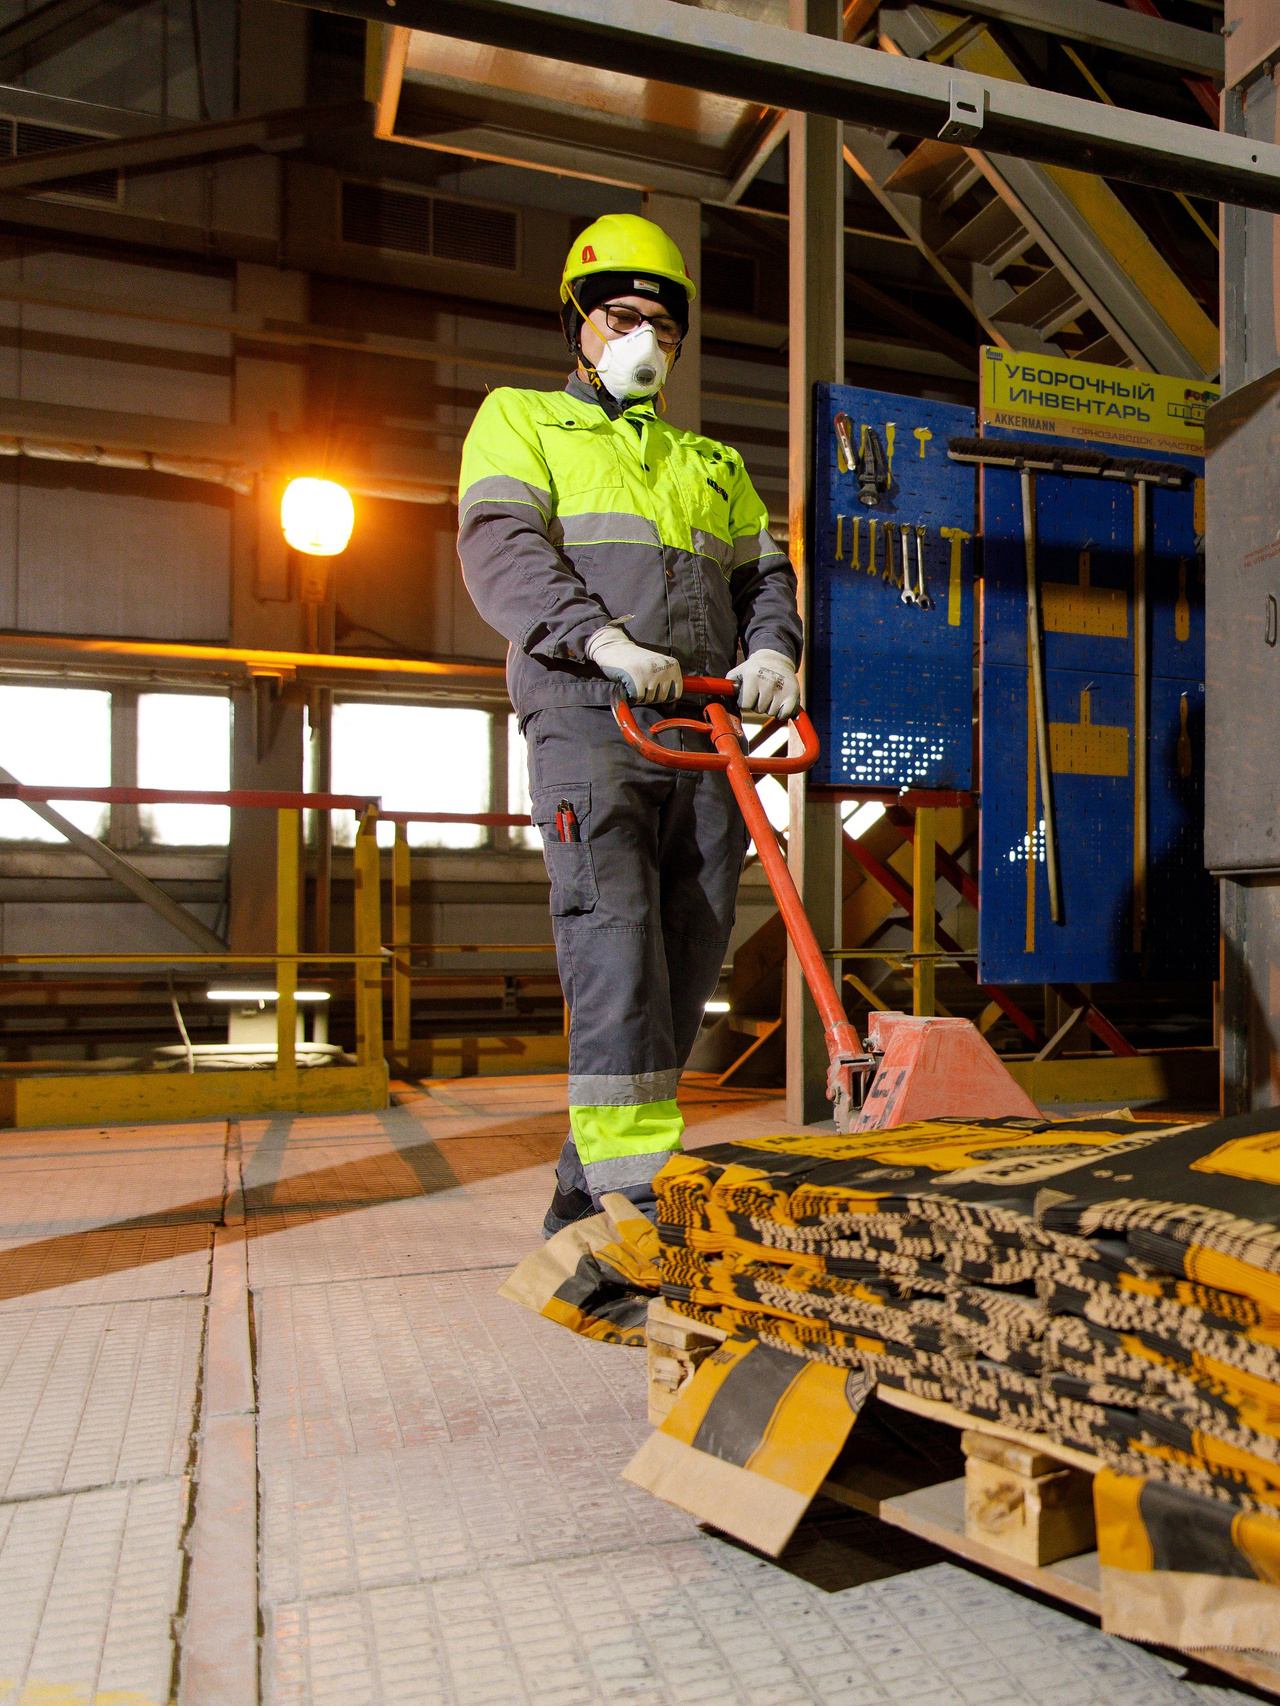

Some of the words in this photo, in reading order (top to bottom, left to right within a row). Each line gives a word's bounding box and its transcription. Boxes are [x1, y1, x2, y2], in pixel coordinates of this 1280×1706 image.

[1004, 363, 1155, 402] УБОРОЧНЫЙ
[1009, 387, 1150, 423] ИНВЕНТАРЬ
[995, 412, 1056, 432] AKKERMANN
[1158, 440, 1204, 453] УЧАСТОК
